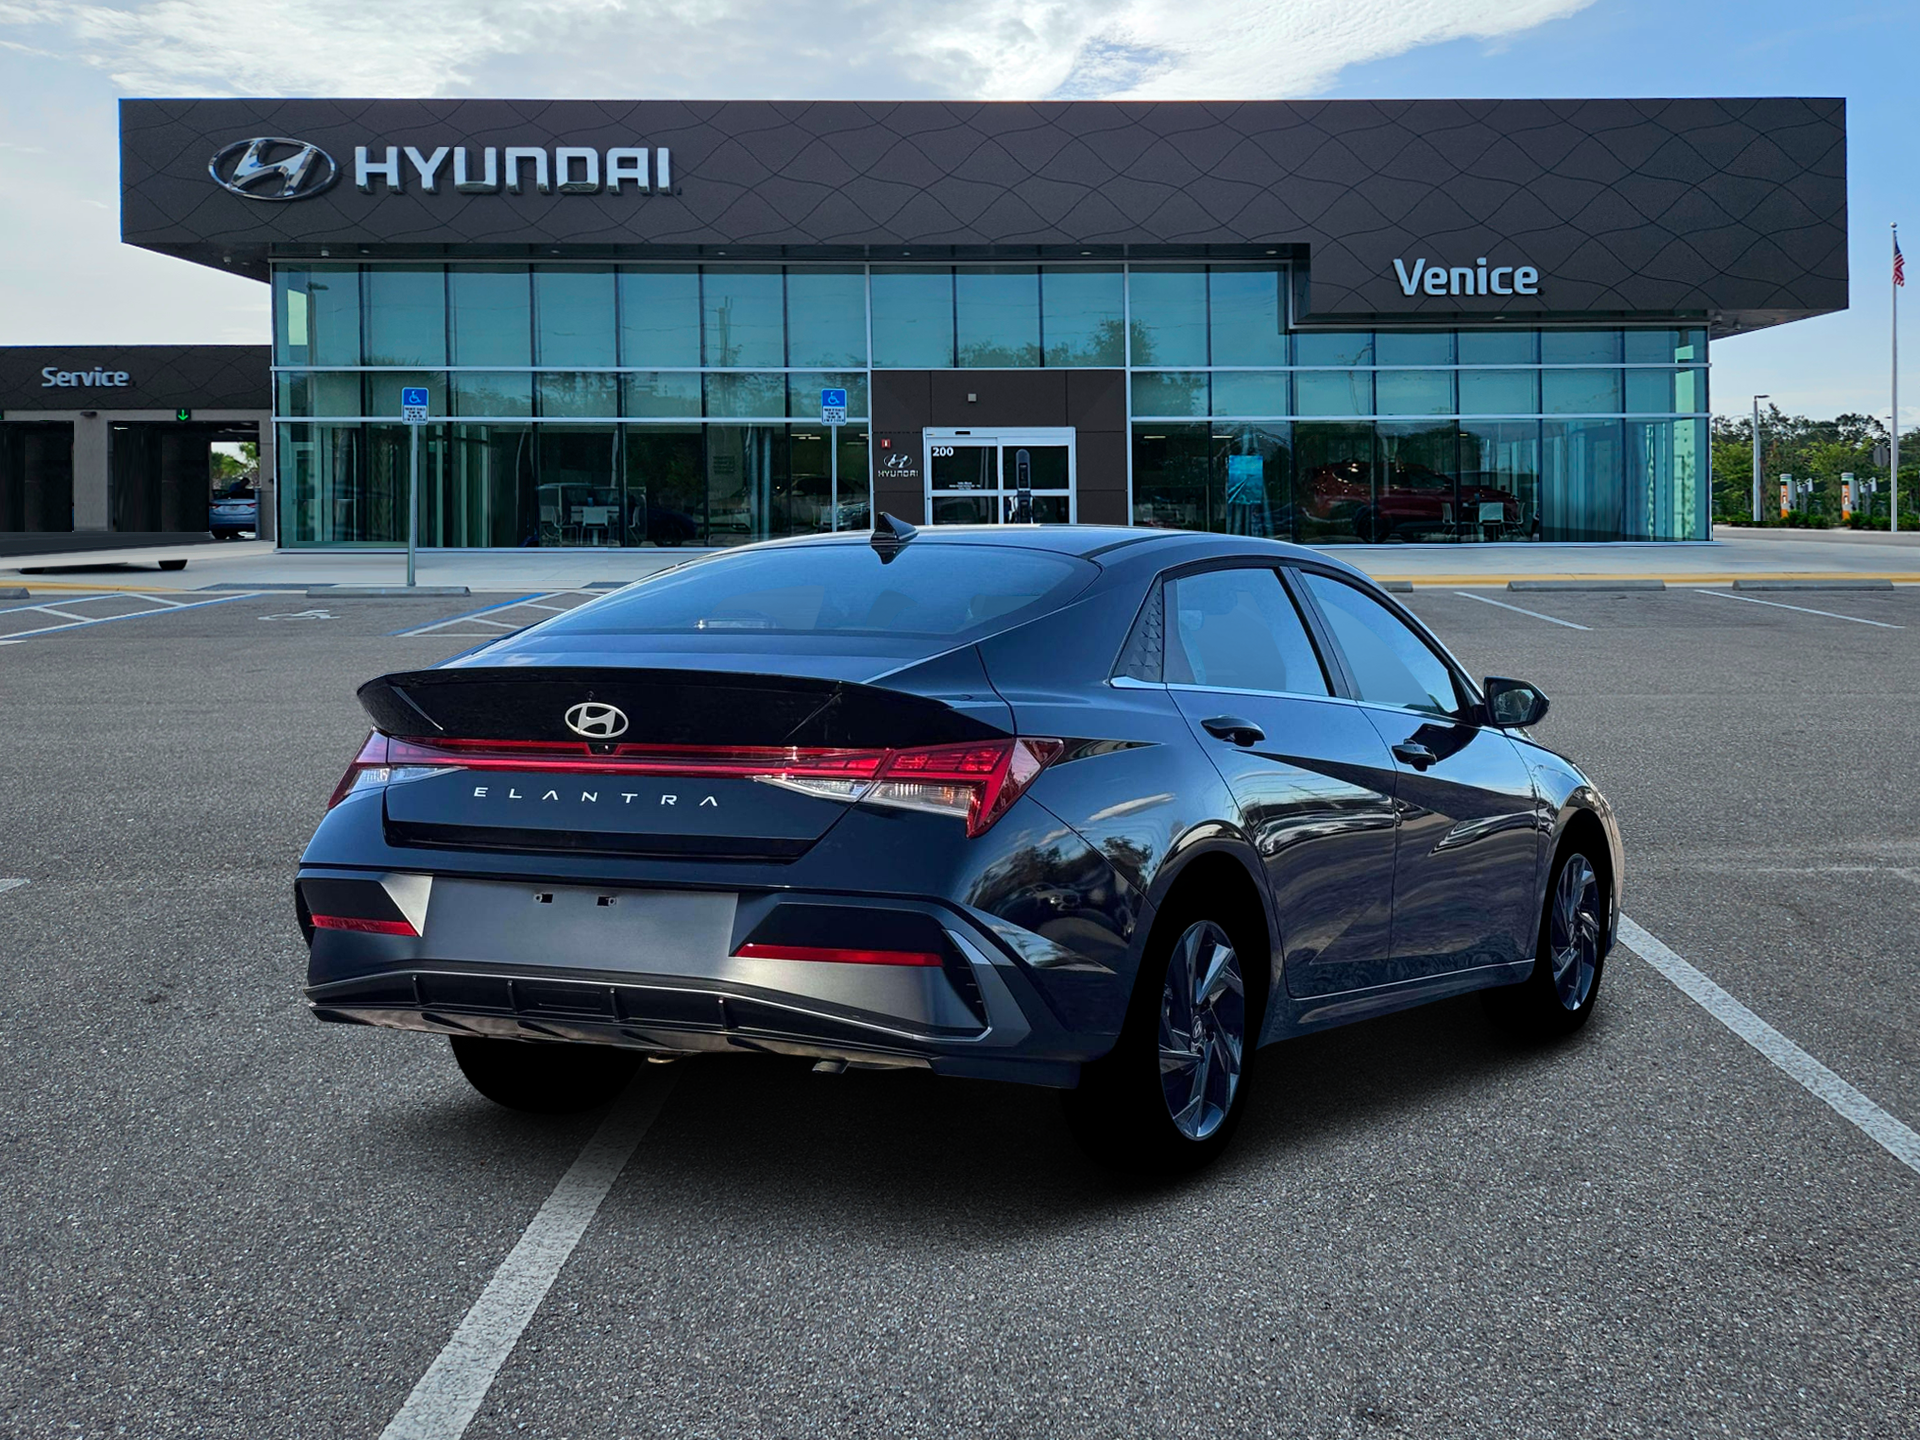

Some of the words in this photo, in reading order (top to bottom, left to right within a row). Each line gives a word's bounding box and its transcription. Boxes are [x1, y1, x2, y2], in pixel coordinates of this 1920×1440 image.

[354, 145, 672, 194] HYUNDAI
[1393, 256, 1538, 296] Venice
[41, 366, 130, 388] Service
[932, 446, 954, 457] 200
[877, 469, 919, 478] HYUNDAI
[473, 786, 718, 807] ELANTRA
